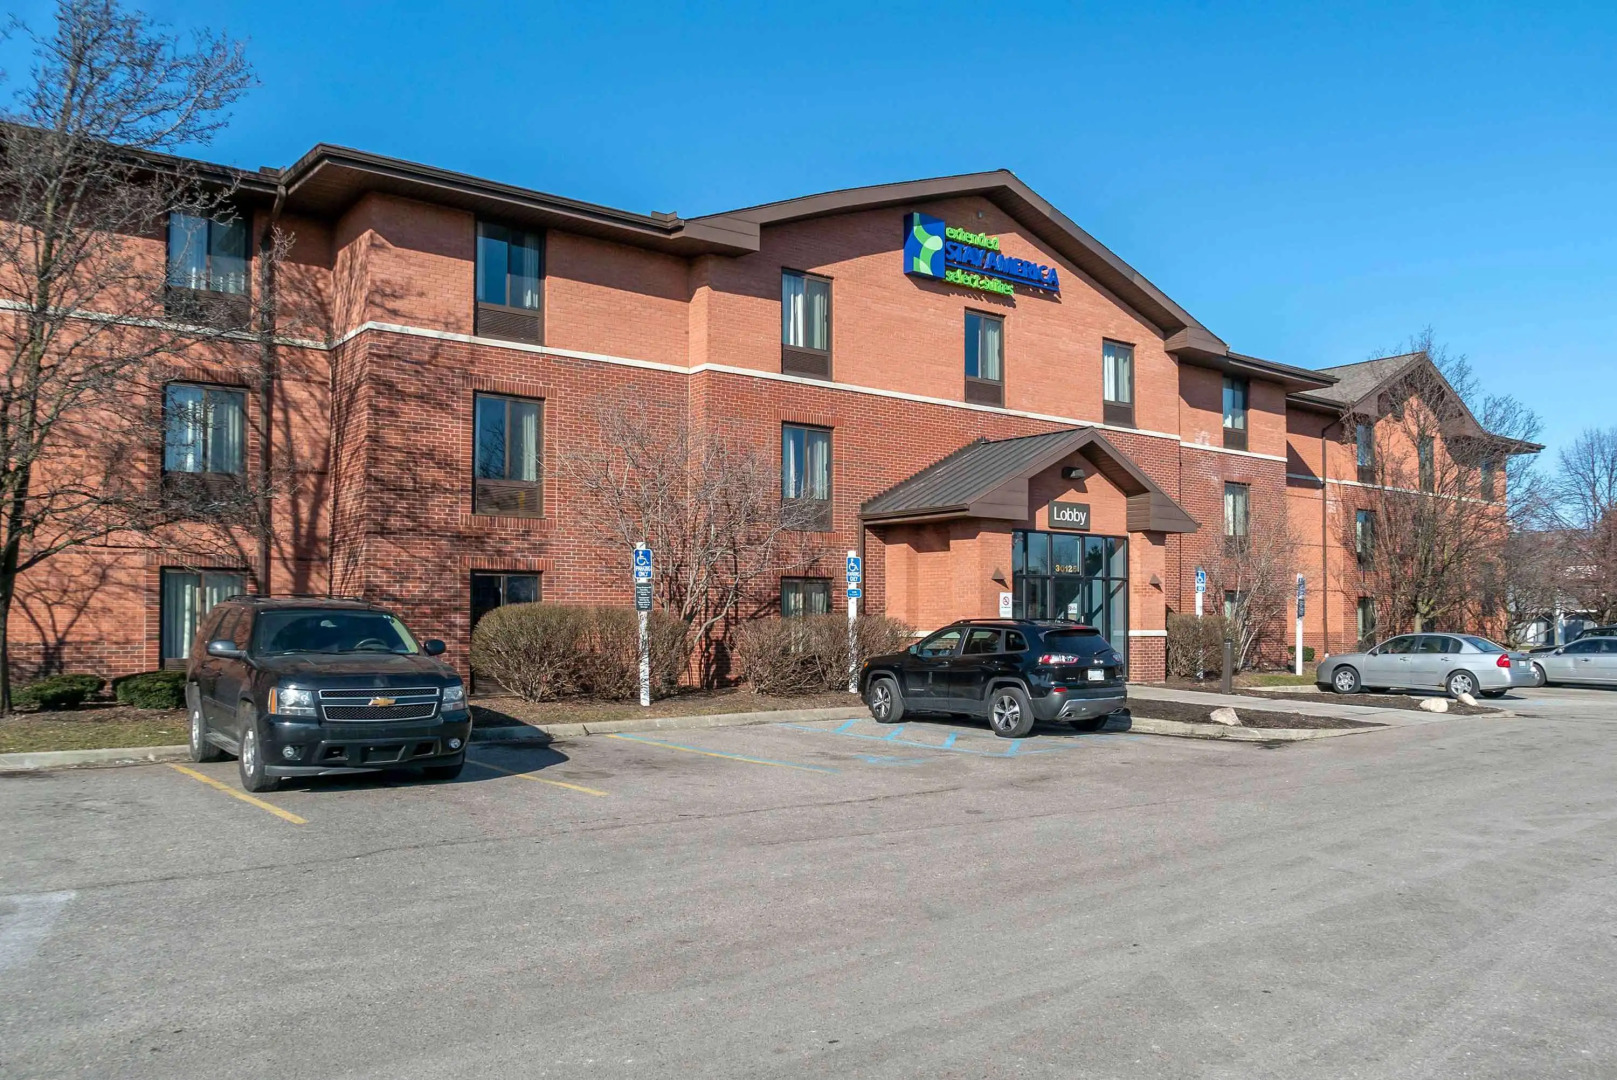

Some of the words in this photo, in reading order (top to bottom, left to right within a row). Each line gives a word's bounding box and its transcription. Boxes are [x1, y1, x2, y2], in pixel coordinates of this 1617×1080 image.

[946, 227, 999, 250] extended
[946, 241, 986, 267] STAY
[983, 251, 1060, 286] AMERICA
[946, 269, 980, 288] select
[980, 278, 1014, 295] suites
[1054, 506, 1087, 525] Lobby
